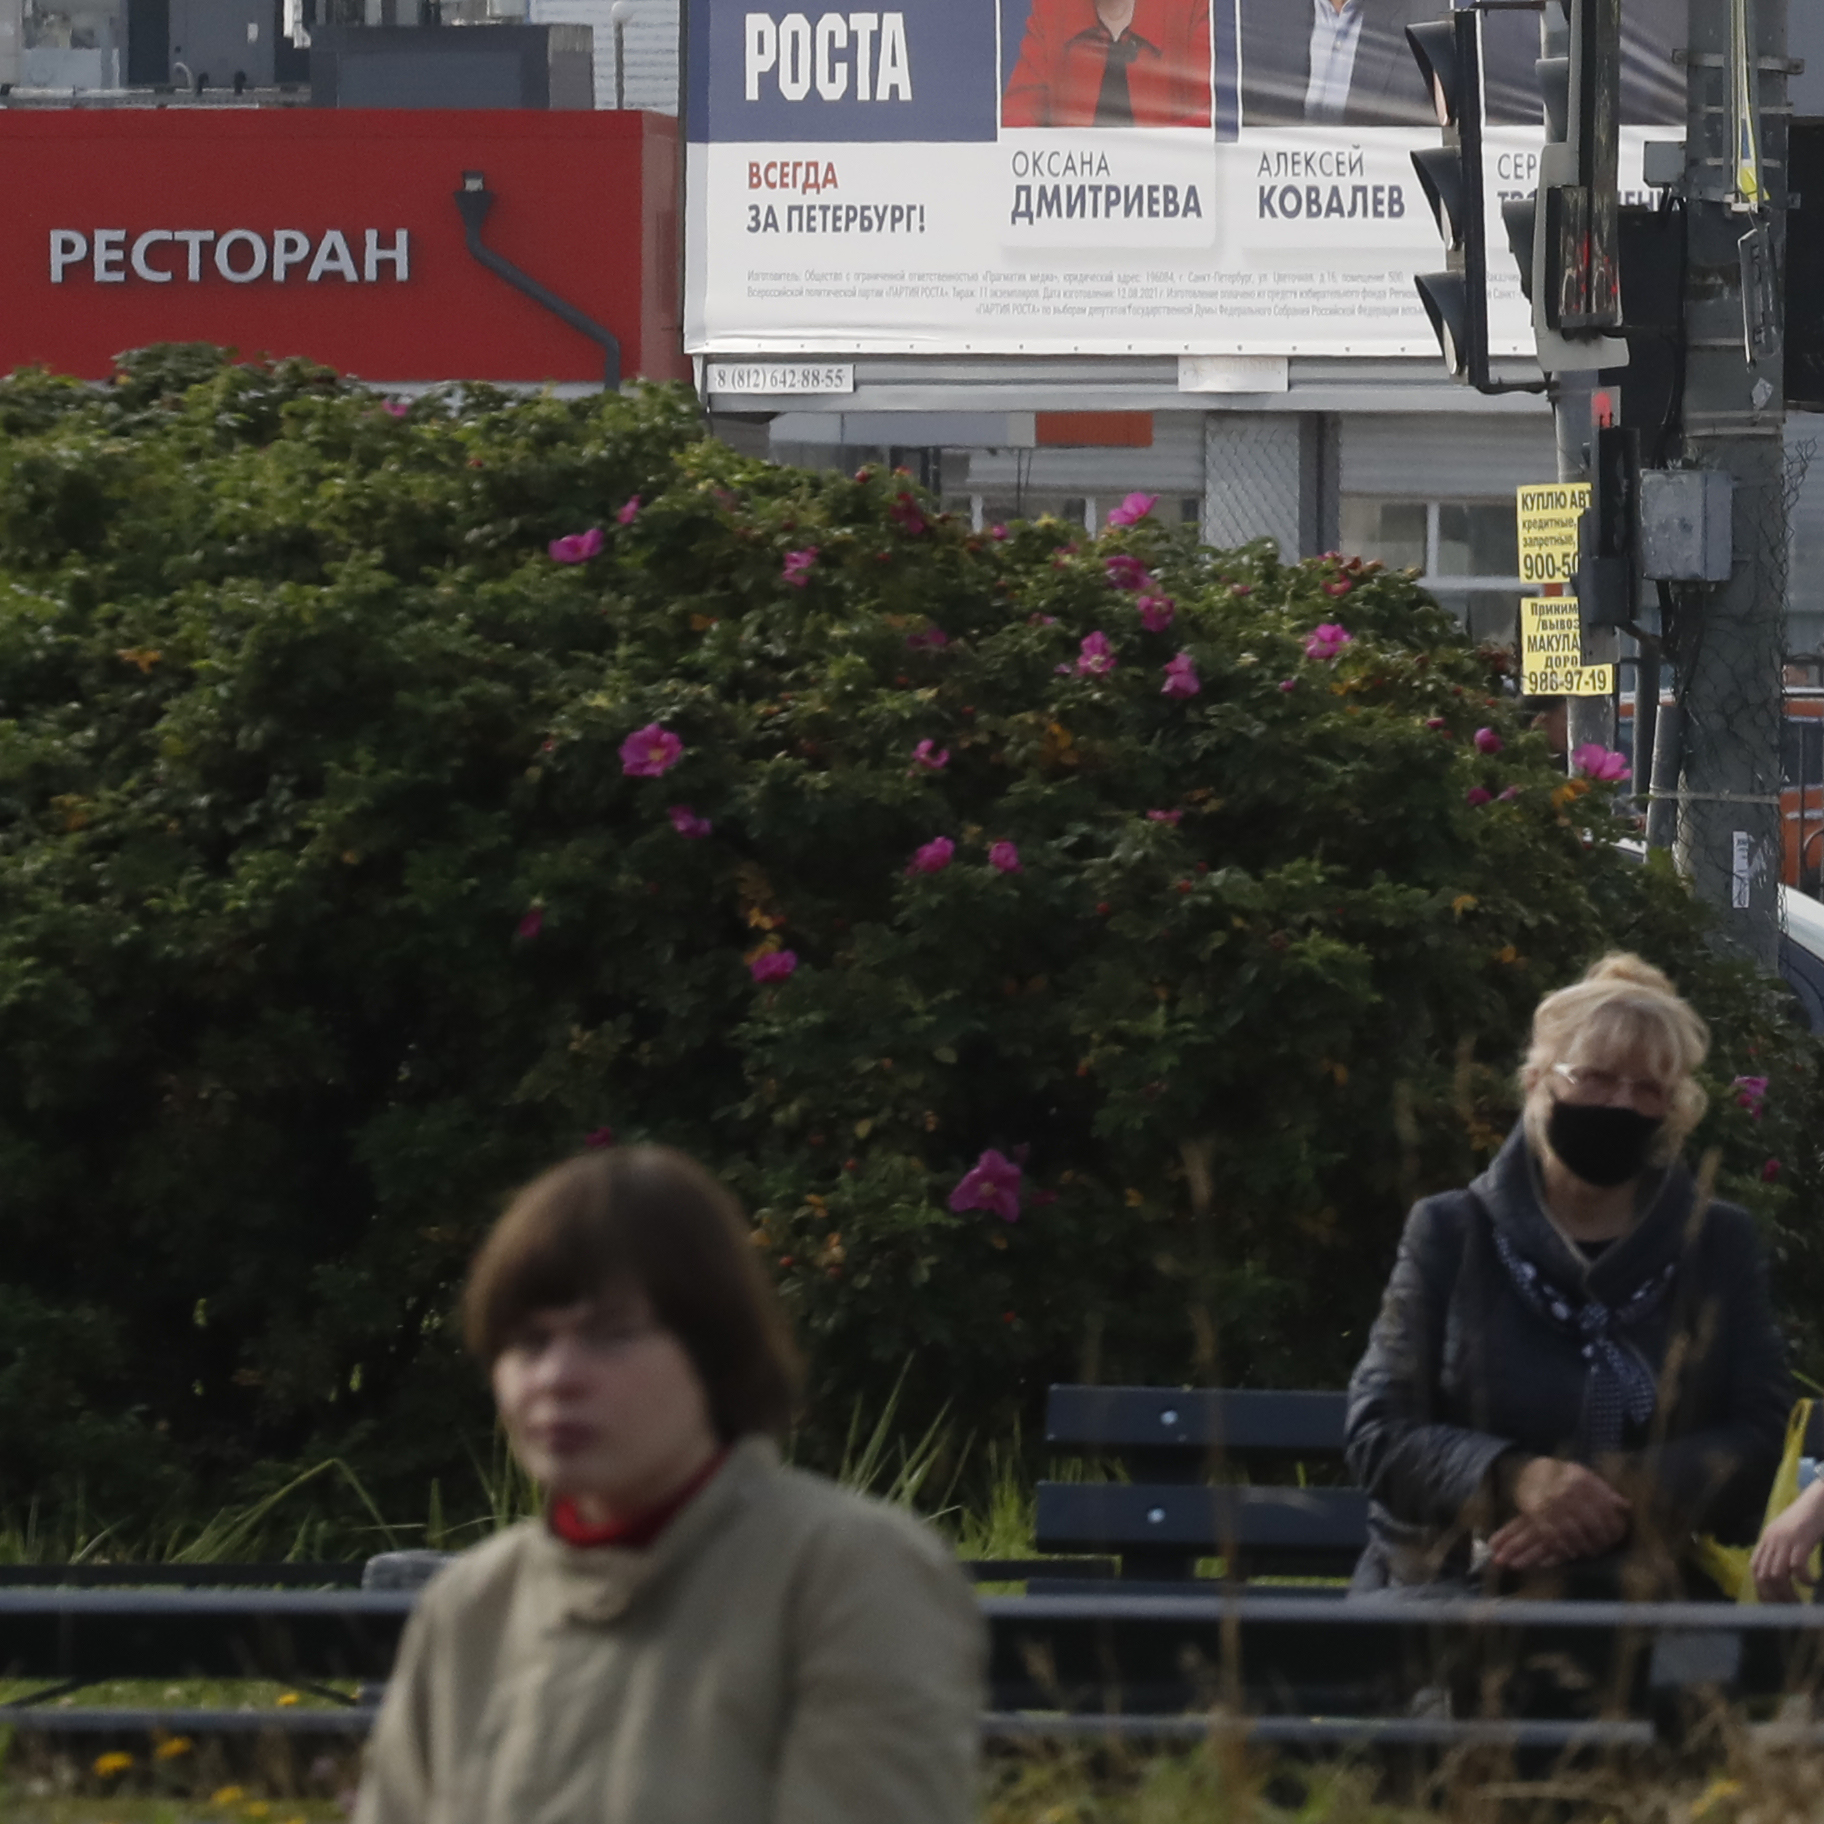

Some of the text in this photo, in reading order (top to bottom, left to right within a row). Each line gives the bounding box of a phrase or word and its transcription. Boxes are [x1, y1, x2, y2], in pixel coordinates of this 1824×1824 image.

[745, 12, 913, 101] РОСТА
[1012, 151, 1111, 178] ОКСАНА
[1257, 143, 1364, 179] АЛЕКСЕЙ
[1497, 152, 1537, 180] СЕР
[748, 161, 839, 196] ВСЕГДА
[1011, 184, 1203, 226] ДМИТРИЕВА
[1258, 185, 1405, 220] КОВАЛЕВ
[746, 203, 926, 234] ЗА ПЕТЕРБУРГ!
[49, 228, 410, 283] РЕСТОРАН
[731, 368, 766, 391] (812)
[770, 368, 844, 389] 642-88-55
[1521, 489, 1592, 512] КУПЛЮ АВТ
[1544, 655, 1579, 670] ДОРО
[1528, 669, 1606, 693] 986-97-19
